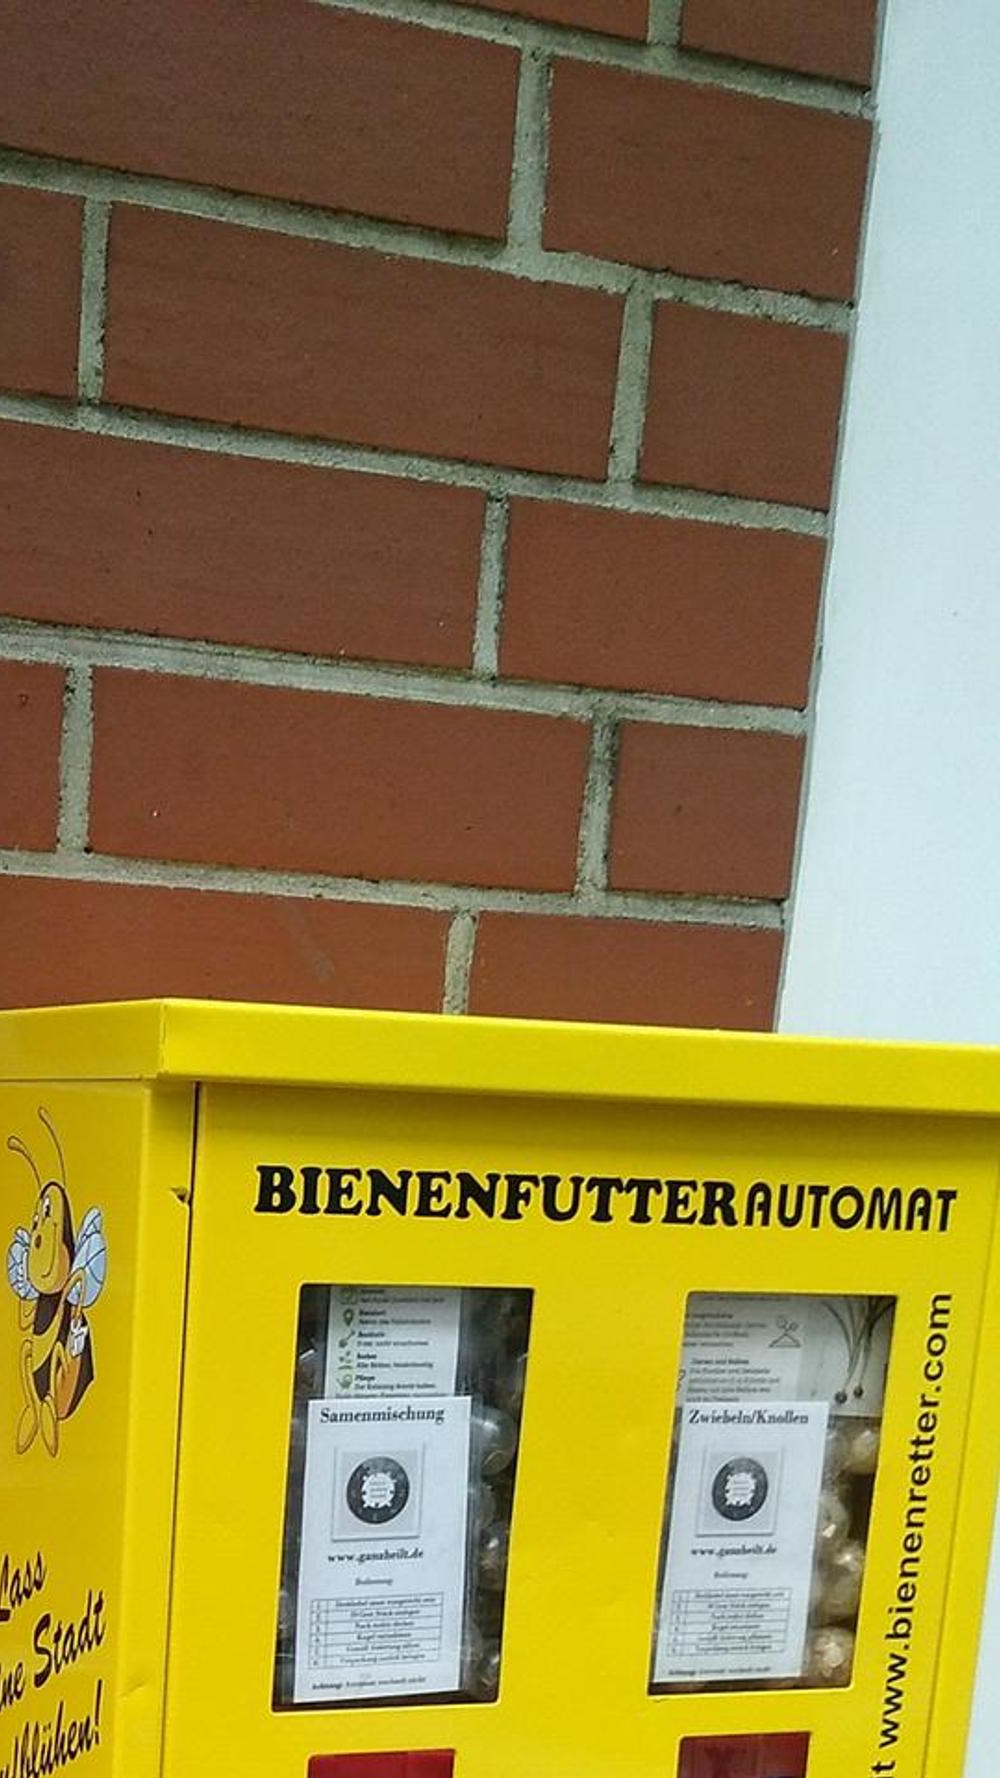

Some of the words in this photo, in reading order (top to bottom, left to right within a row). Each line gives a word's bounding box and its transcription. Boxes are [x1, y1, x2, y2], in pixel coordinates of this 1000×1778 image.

[320, 1406, 445, 1425] Samenmischung
[689, 1408, 809, 1425] Zwiebeln/Knollen
[878, 1293, 952, 1748] www.bienenretter.com
[33, 1589, 106, 1688] Stadt
